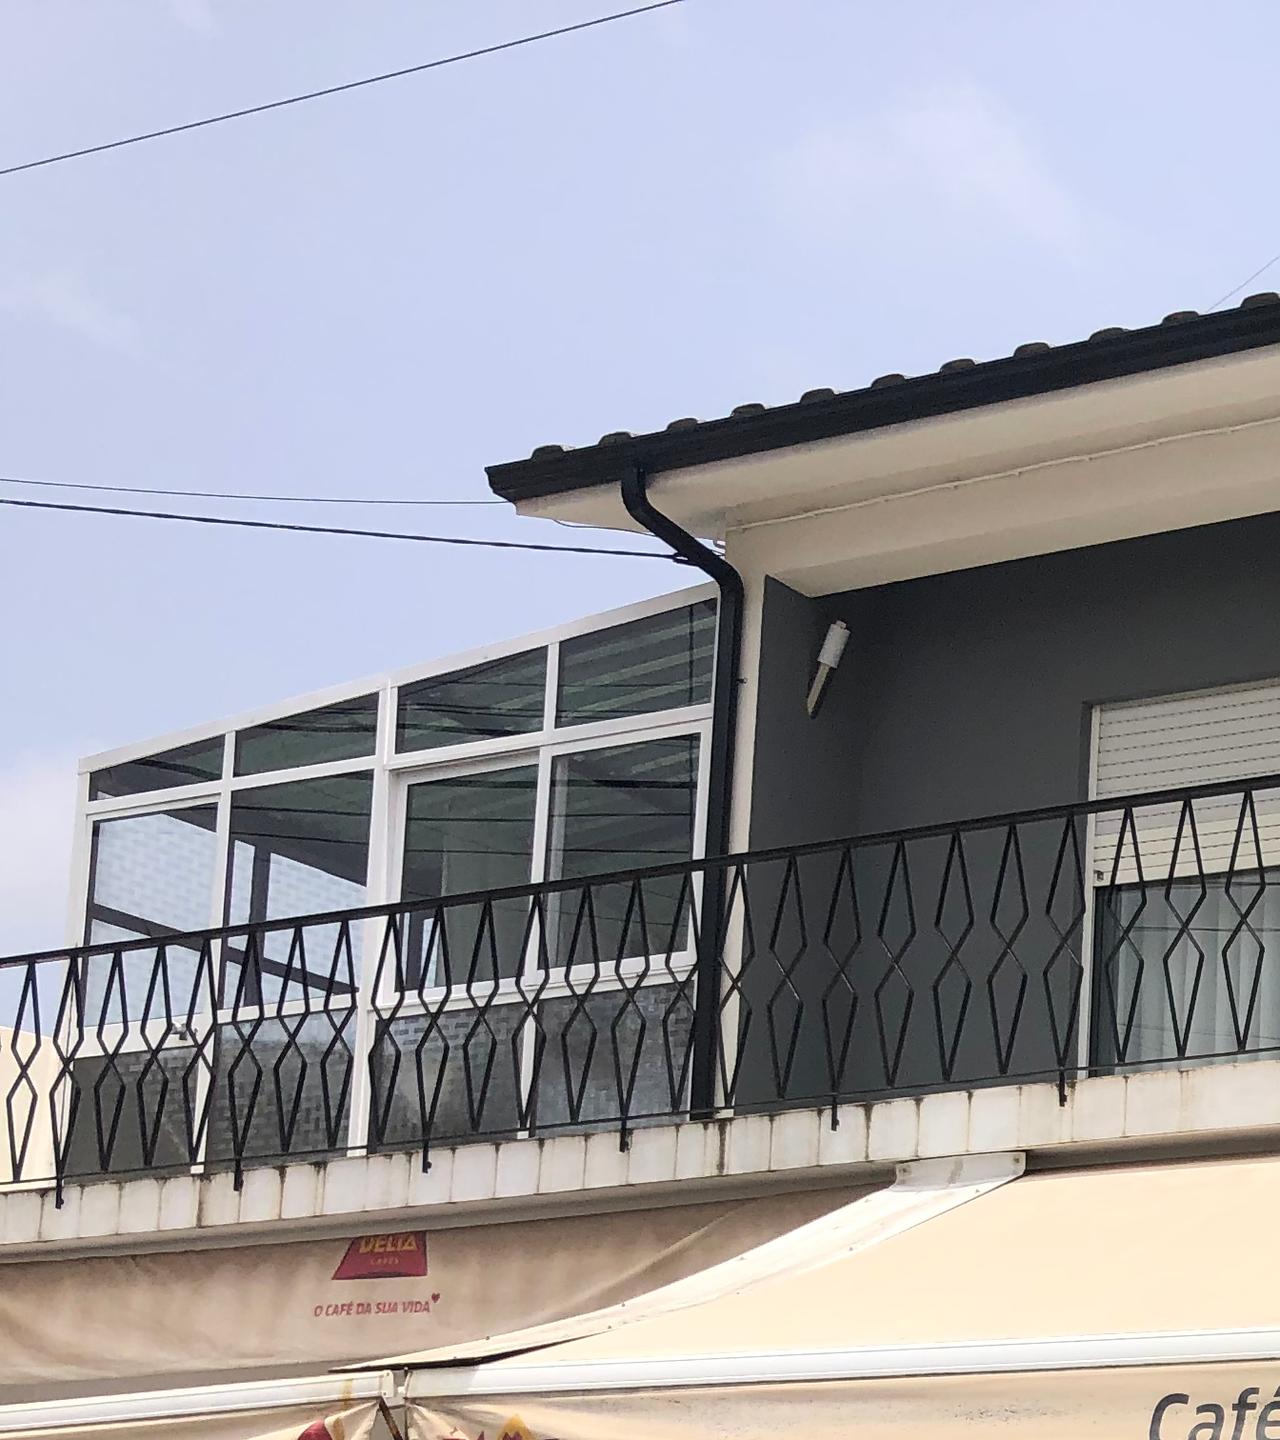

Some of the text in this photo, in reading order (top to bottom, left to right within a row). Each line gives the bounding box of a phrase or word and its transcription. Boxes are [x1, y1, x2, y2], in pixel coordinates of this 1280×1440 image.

[359, 1233, 417, 1253] DELTA
[314, 1301, 431, 1317] O CAFÉ DA SUA VIDA
